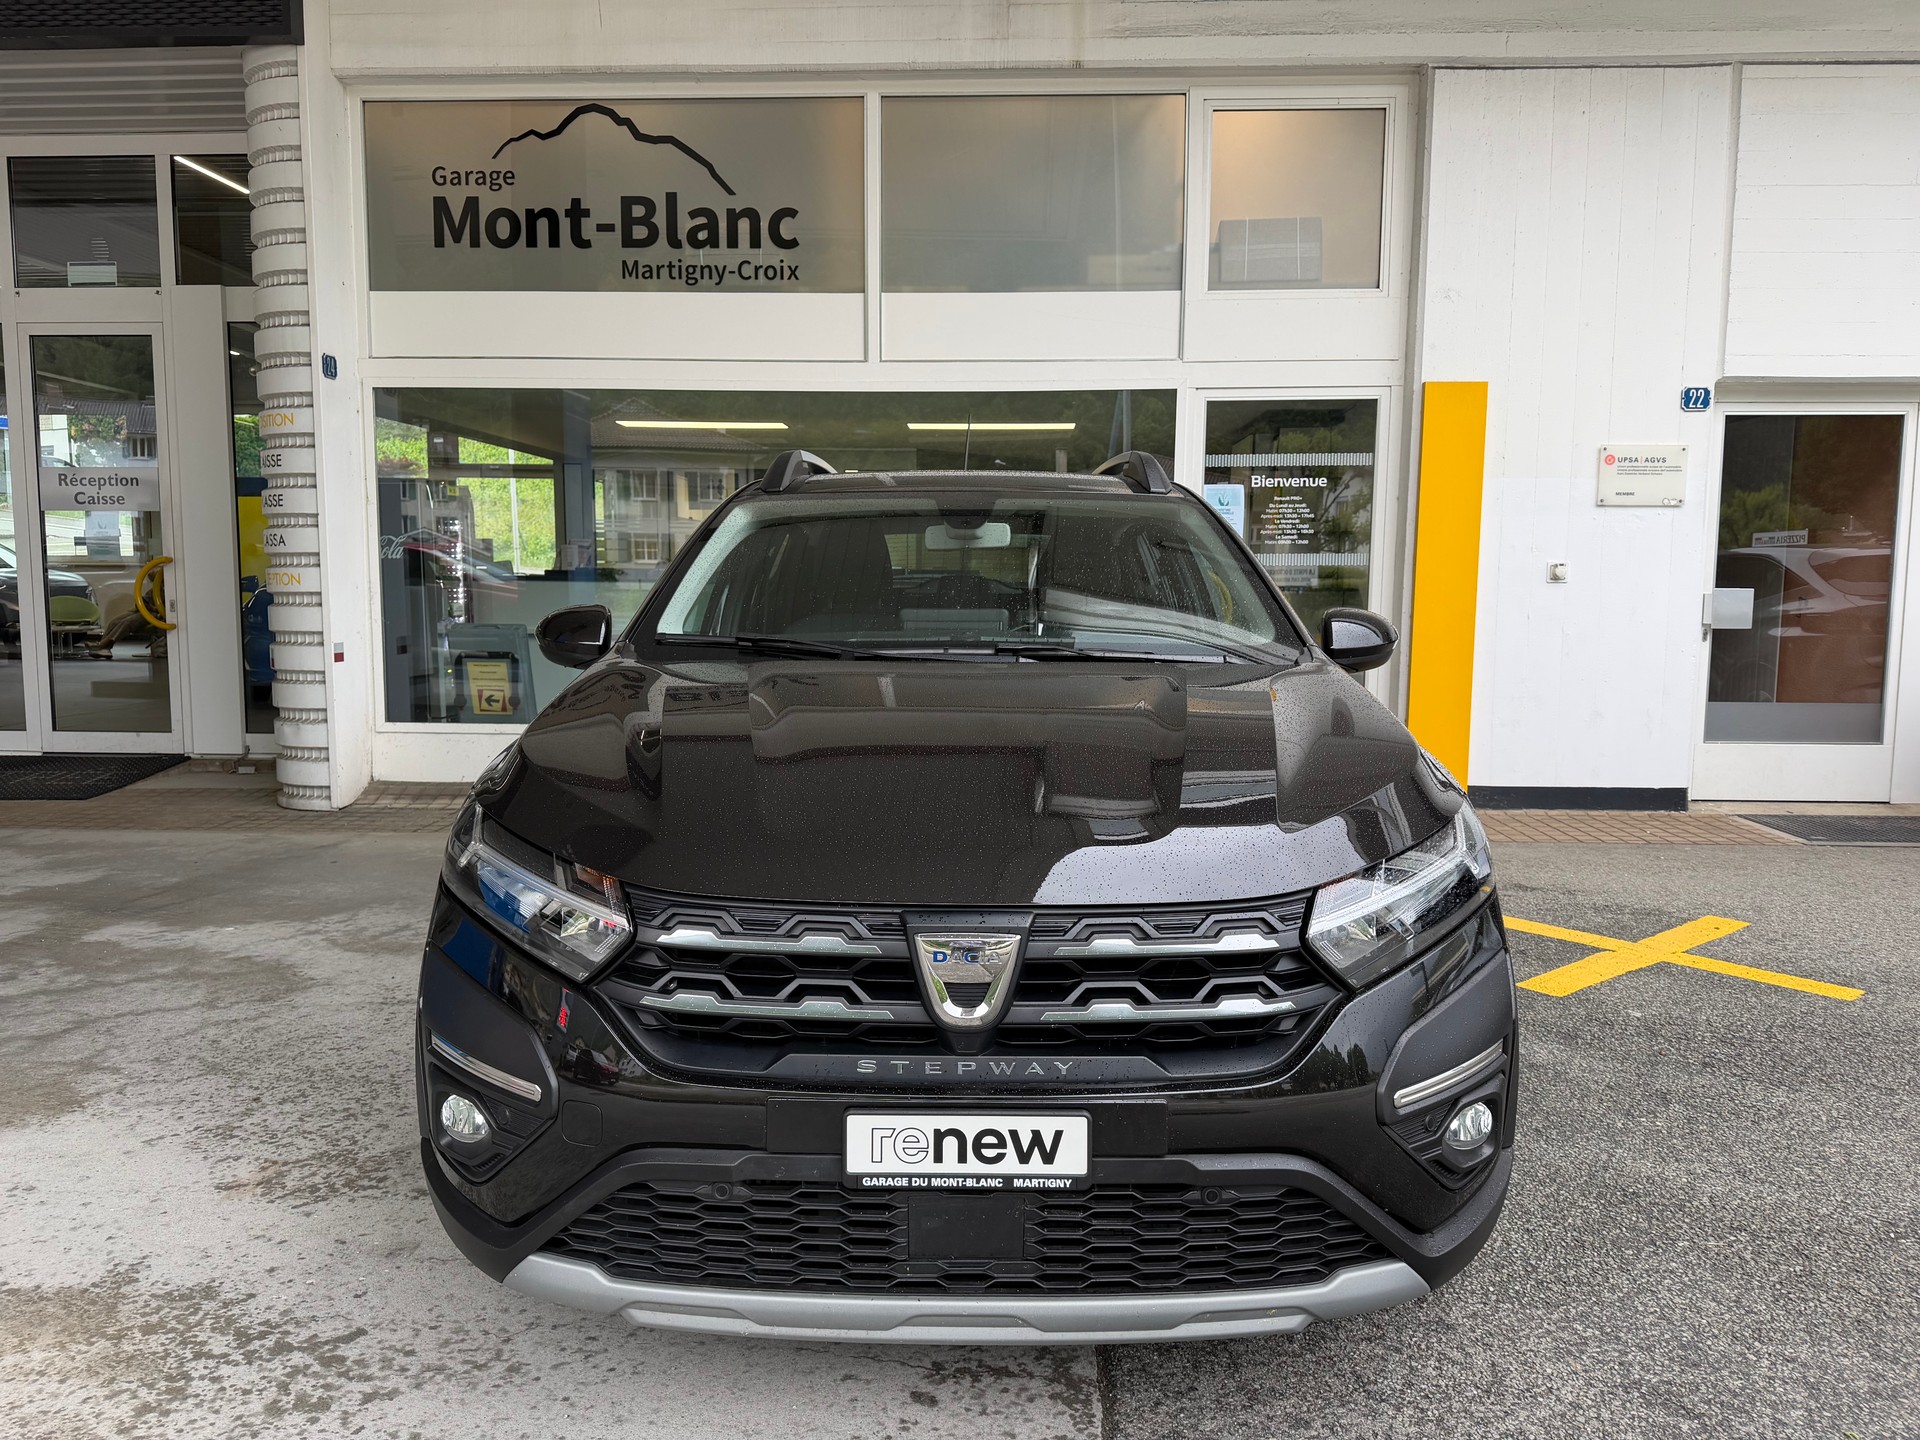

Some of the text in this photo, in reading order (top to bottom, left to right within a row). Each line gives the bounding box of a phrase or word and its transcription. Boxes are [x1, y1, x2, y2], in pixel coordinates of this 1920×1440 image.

[431, 166, 516, 191] Garage
[432, 191, 800, 250] Mont-Blanc
[621, 259, 800, 286] Martigny-Croix
[1688, 388, 1705, 408] 22
[260, 412, 294, 428] SITION
[1617, 456, 1667, 464] UPSA AGVS
[57, 473, 139, 491] Réception
[1251, 475, 1328, 488] Bienvenue
[73, 491, 126, 505] Caisse
[262, 493, 284, 508] ASSE
[932, 951, 1002, 965] DACIA
[856, 1060, 1073, 1076] STEPWAY
[871, 1127, 1064, 1165] renew
[862, 1177, 1072, 1188] GARAGE DU MONT-BLANC MARTIGNY
